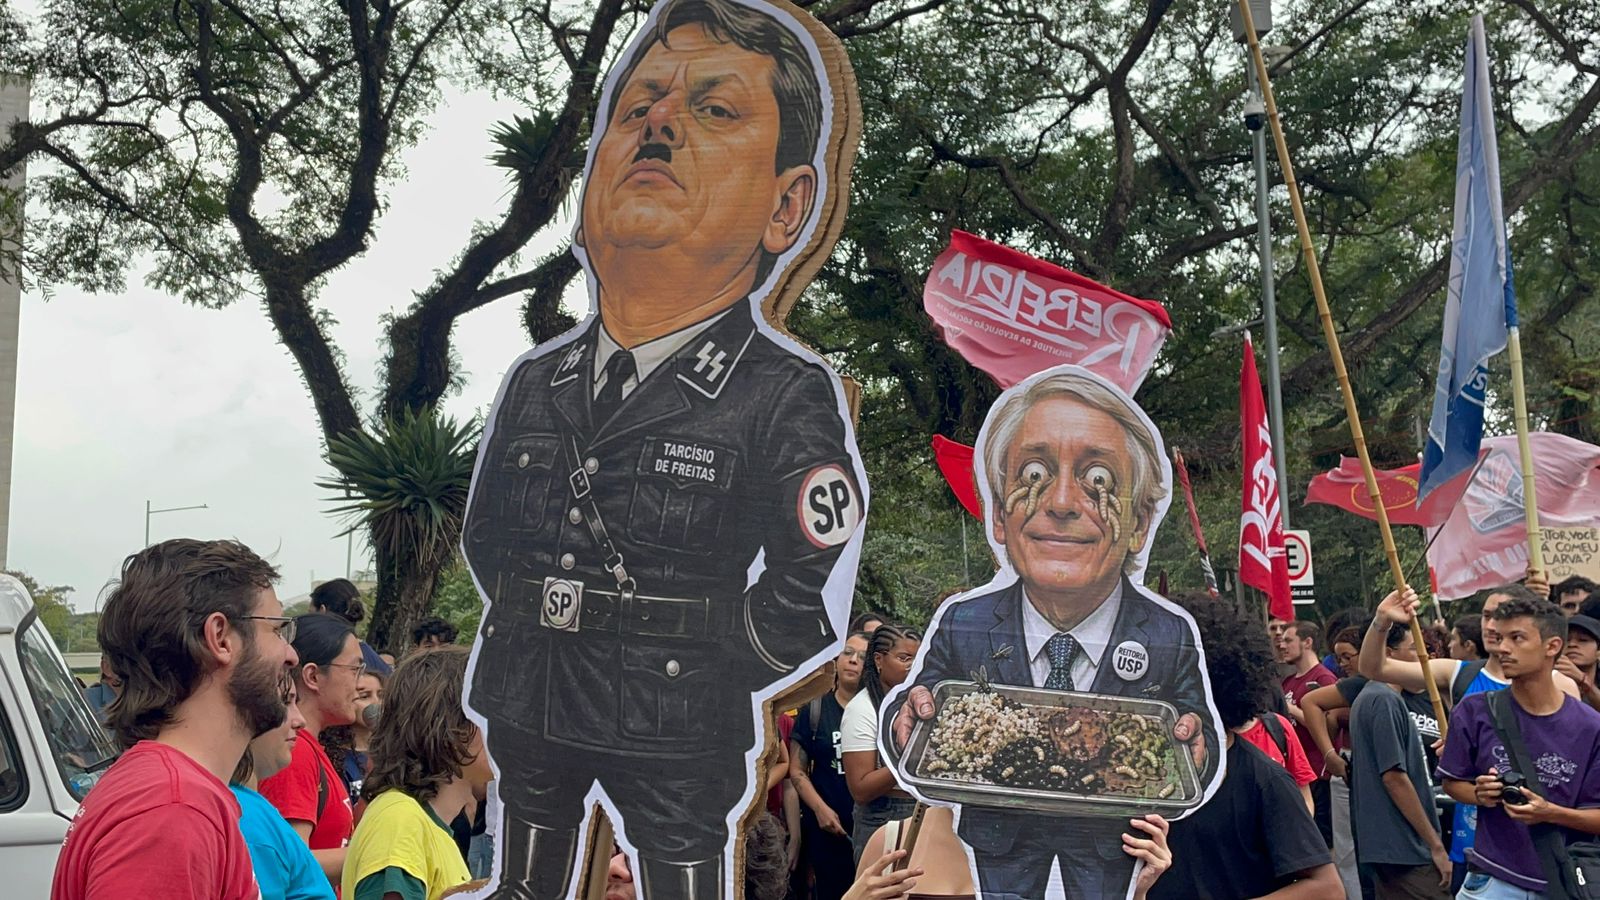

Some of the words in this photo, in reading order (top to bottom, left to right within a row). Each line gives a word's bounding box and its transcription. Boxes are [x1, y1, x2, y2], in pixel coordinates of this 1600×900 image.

[664, 442, 715, 464] TARCÍSIO
[655, 458, 670, 473] DE
[671, 461, 716, 482] FREITAS
[808, 479, 850, 535] SP
[1286, 545, 1299, 569] E
[1555, 541, 1599, 553] COMEU
[1542, 552, 1592, 565] LARVA?
[548, 592, 572, 616] SP
[1118, 646, 1146, 661] REITORIA
[1117, 656, 1143, 674] USP
